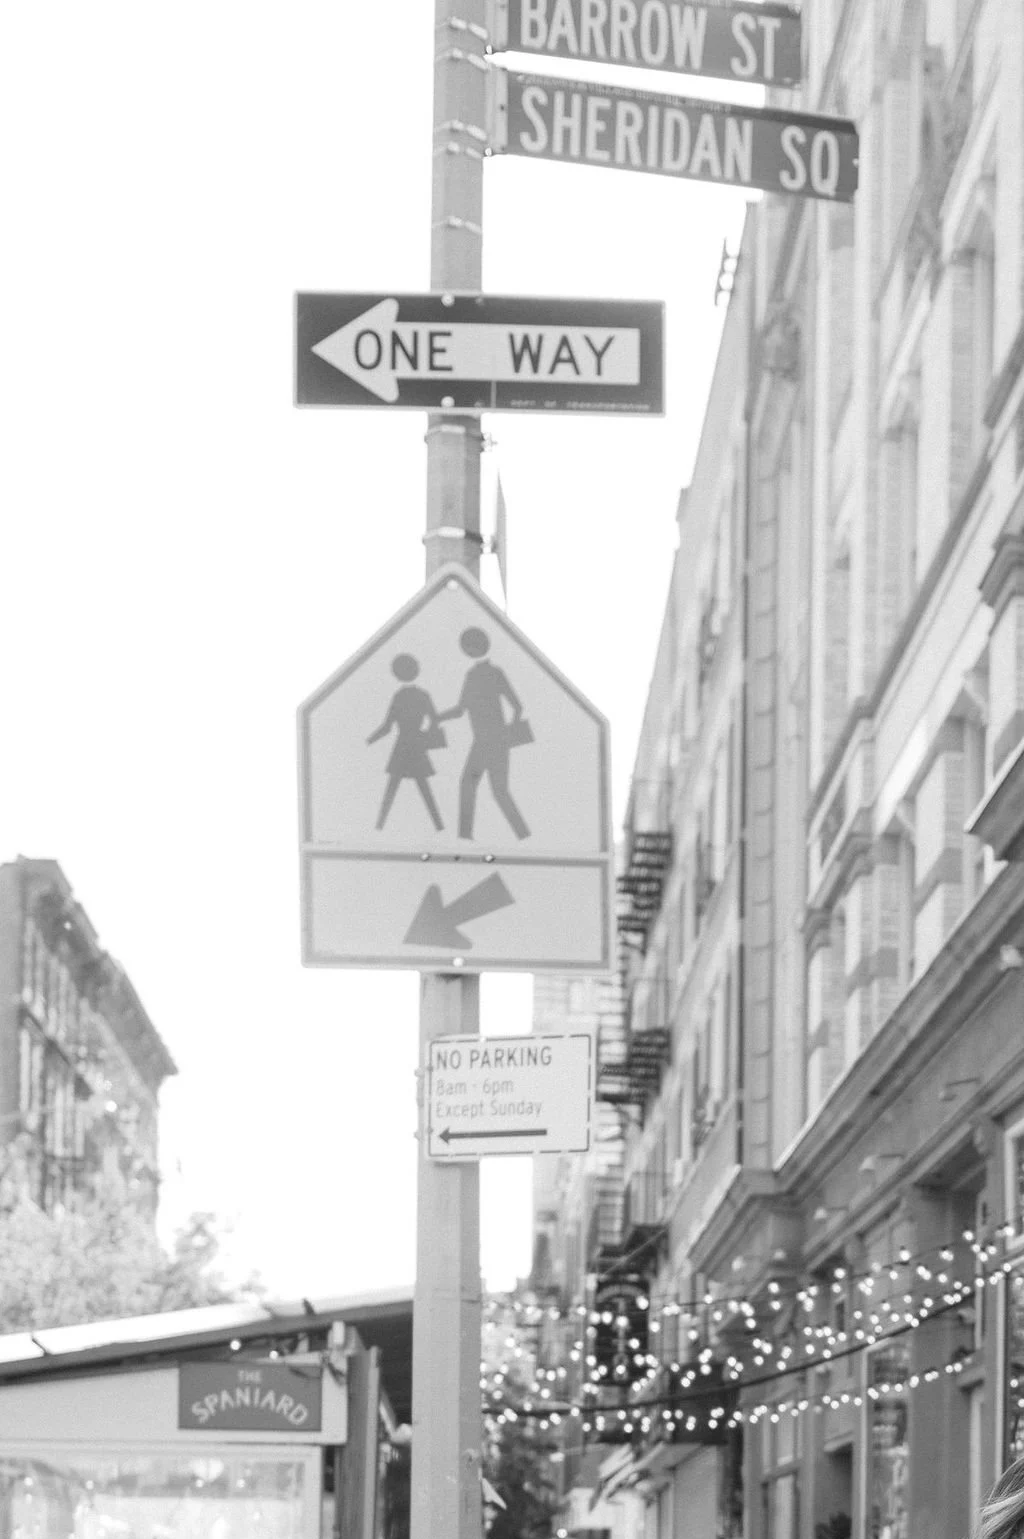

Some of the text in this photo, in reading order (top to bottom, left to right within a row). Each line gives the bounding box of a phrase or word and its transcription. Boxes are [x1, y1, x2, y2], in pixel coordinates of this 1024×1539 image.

[520, 0, 781, 80] BARROW ST
[519, 86, 752, 182] SHERIDAN
[779, 125, 839, 196] SQ
[354, 329, 615, 376] ONE WAY
[436, 1046, 552, 1070] NO PARKING
[436, 1080, 467, 1096] 8am
[482, 1078, 514, 1096] 6pm
[436, 1099, 542, 1119] Except Sunday
[238, 1369, 262, 1382] THE
[191, 1387, 308, 1425] SPANIARD
